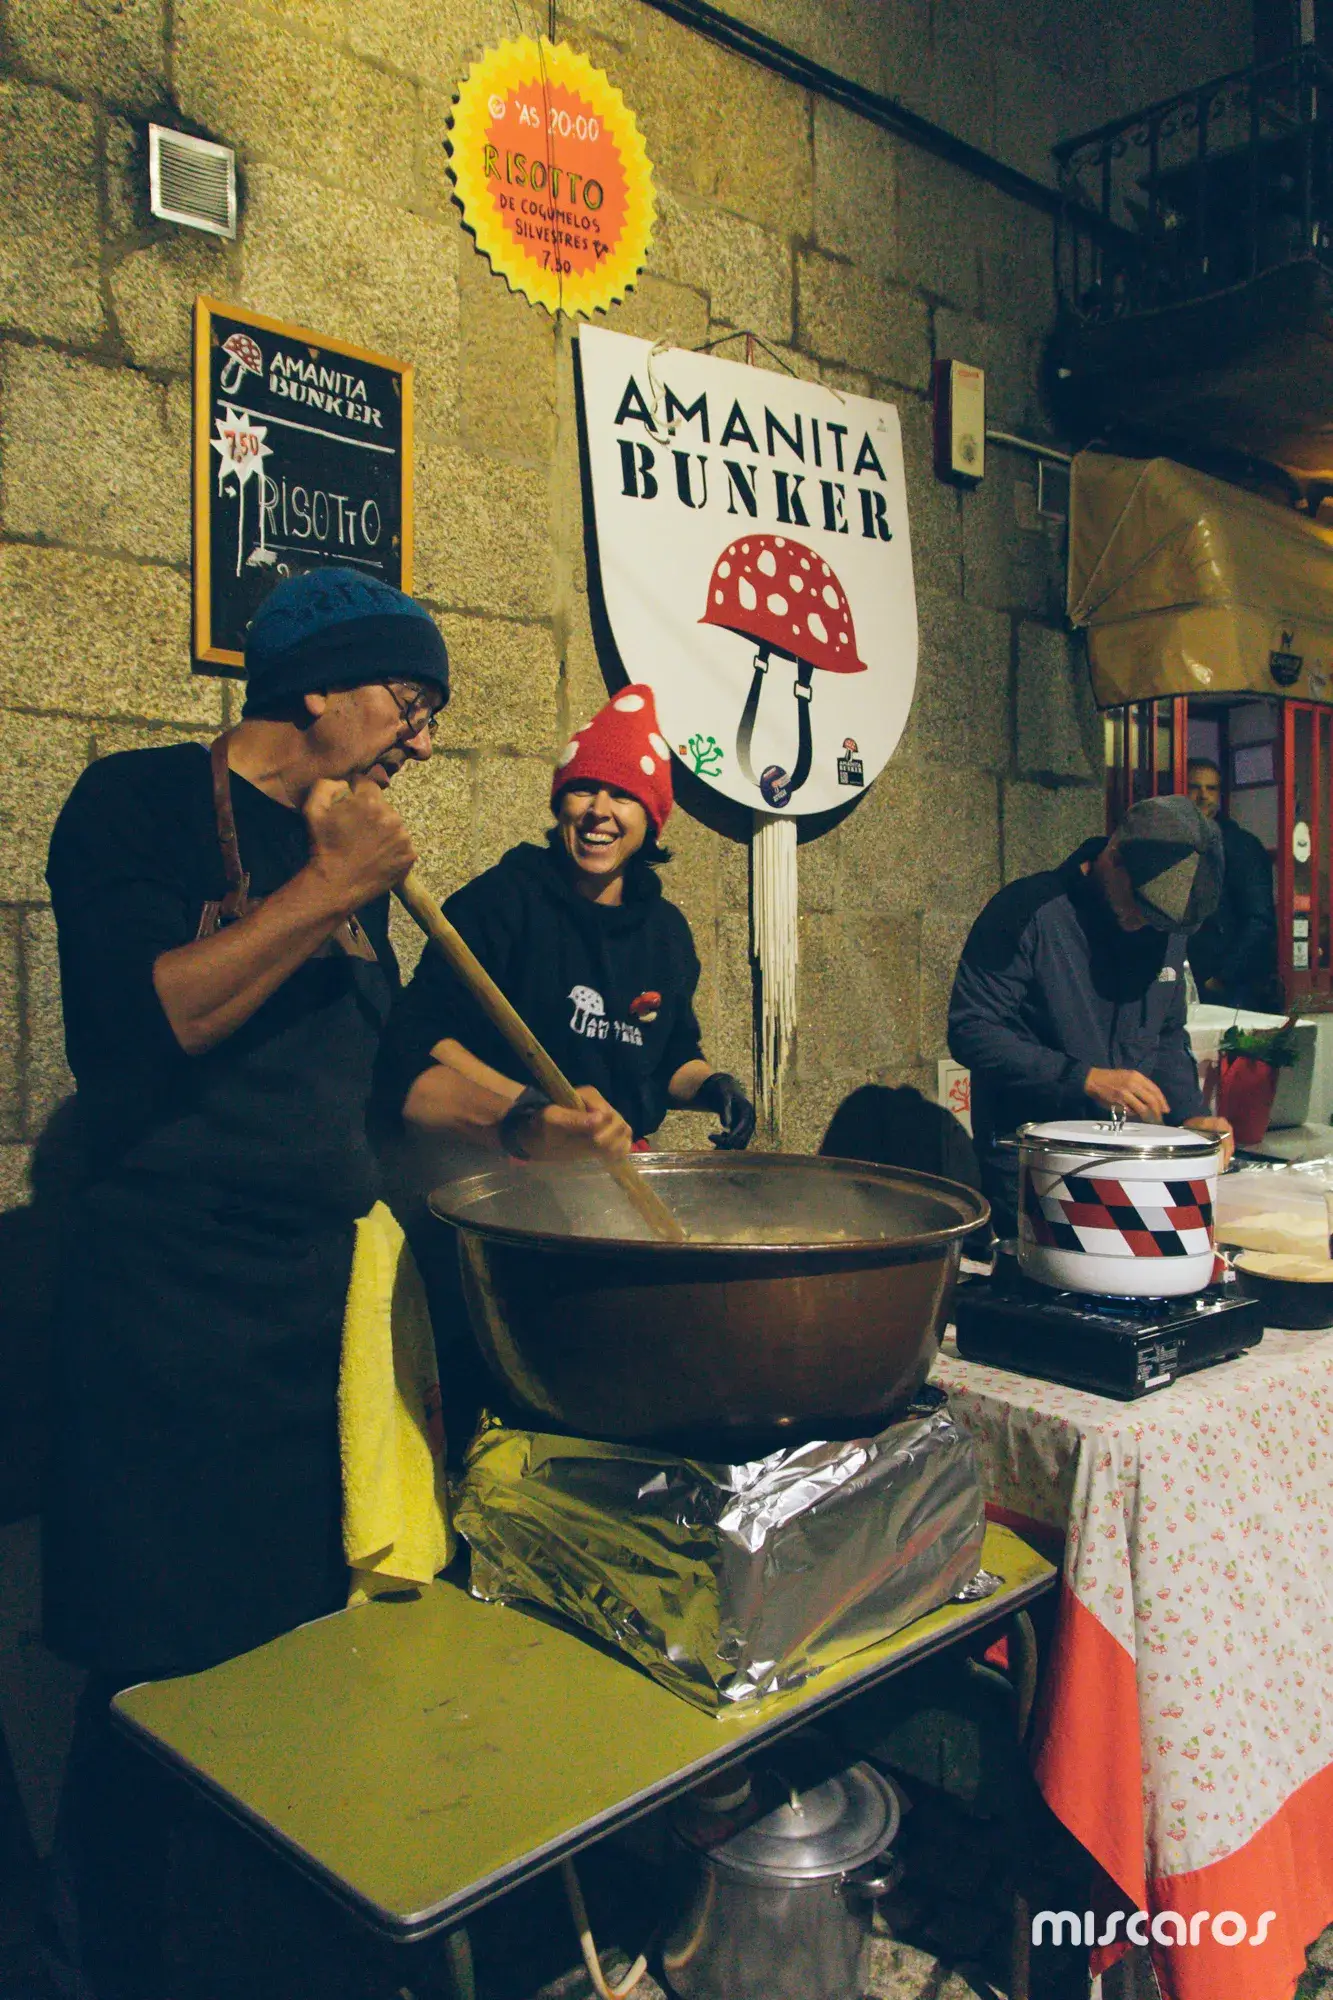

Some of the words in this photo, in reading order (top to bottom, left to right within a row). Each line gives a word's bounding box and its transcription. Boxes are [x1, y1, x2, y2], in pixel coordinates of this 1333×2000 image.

[547, 107, 600, 142] 20:00
[484, 143, 604, 210] RISOTTO
[500, 192, 516, 211] DE
[520, 198, 601, 234] COGUMELOS
[515, 217, 589, 251] SILVESTRES
[542, 250, 572, 274] 7.50
[269, 351, 368, 402] AMANITA
[269, 373, 383, 429] BUNKER
[613, 374, 888, 482] AMANITA
[616, 438, 893, 543] BUNKER
